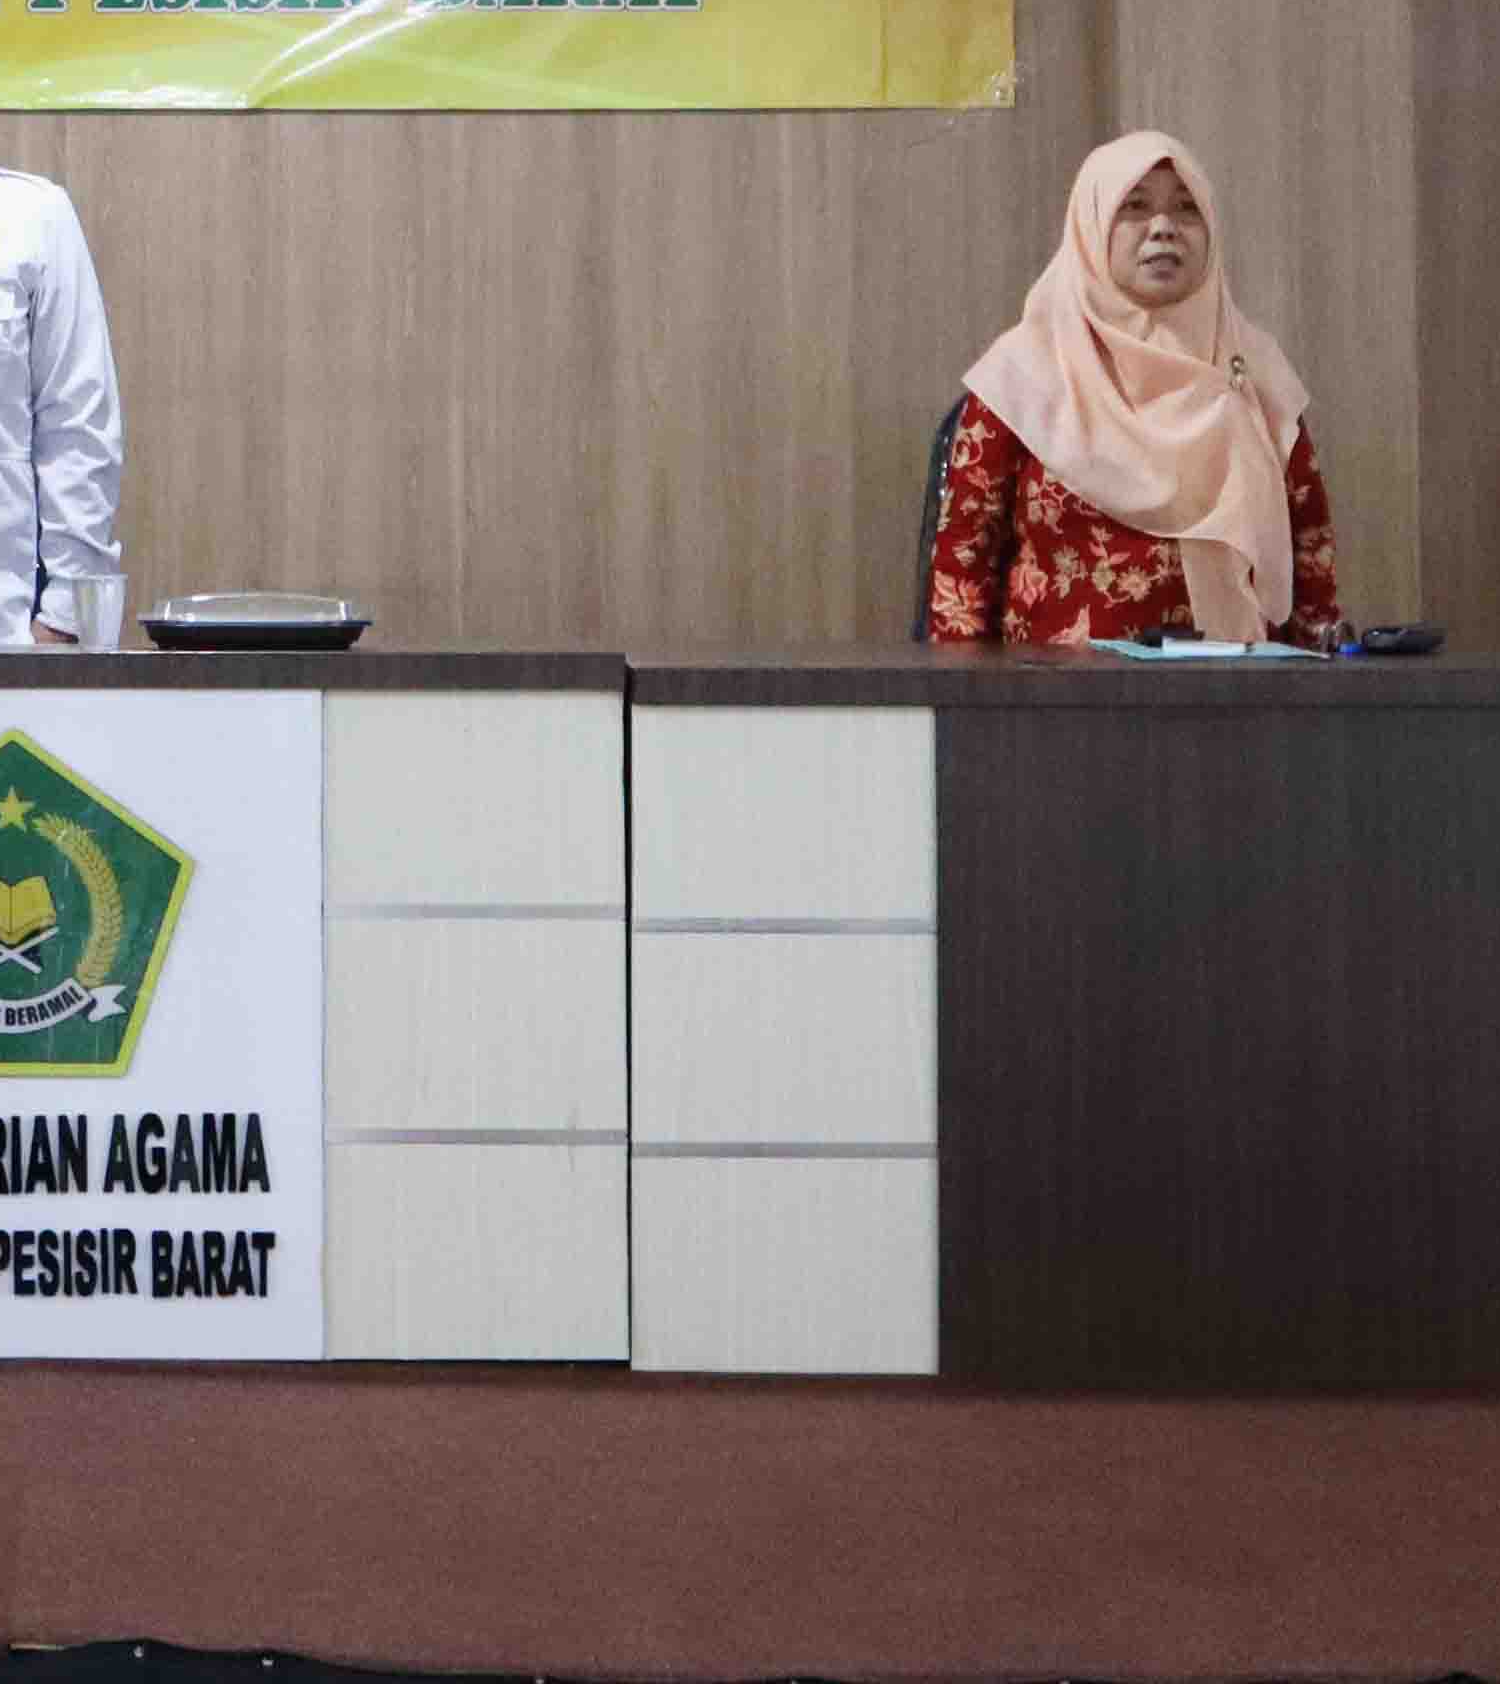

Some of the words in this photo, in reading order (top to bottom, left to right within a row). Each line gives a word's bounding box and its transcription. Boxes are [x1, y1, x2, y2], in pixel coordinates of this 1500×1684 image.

[4, 984, 84, 1027] BERAMAL
[102, 1114, 271, 1194] AGAMA
[150, 1231, 276, 1299] BARAT
